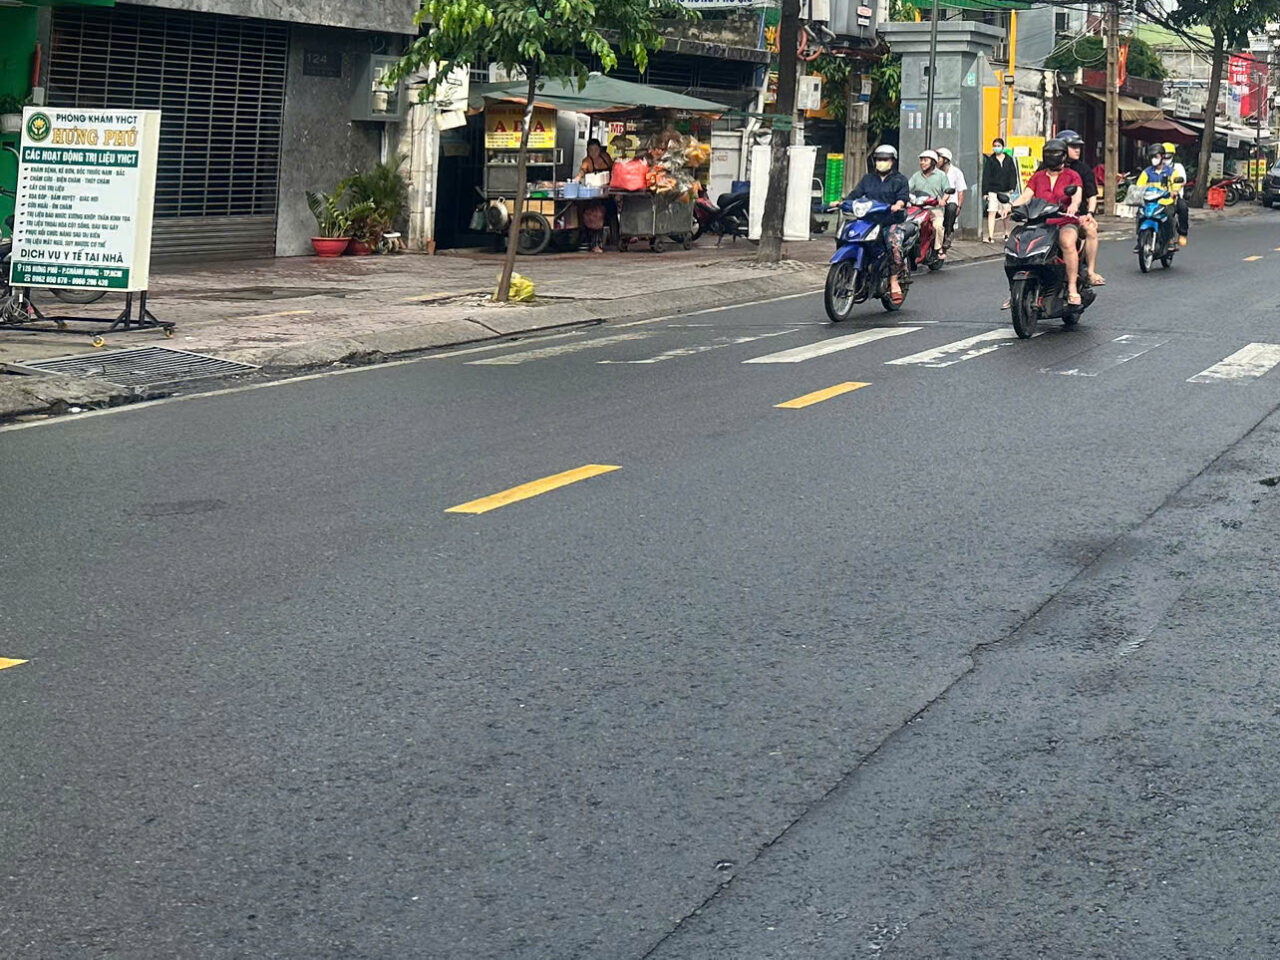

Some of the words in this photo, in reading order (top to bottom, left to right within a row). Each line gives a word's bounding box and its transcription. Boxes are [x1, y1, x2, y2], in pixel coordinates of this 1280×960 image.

[306, 53, 327, 64] 124
[56, 111, 87, 123] PHÒNG
[88, 112, 113, 124] KHÁM
[115, 114, 138, 124] YHCT
[52, 126, 99, 146] HƯNG
[103, 127, 139, 147] PHÚ
[25, 148, 41, 160] CÁC
[41, 150, 61, 163] HOẠT
[63, 150, 84, 163] ĐỘNG
[85, 152, 97, 165] TRỊ
[98, 152, 116, 165] LIỆU
[117, 153, 137, 164] YHCT
[21, 248, 45, 260] DỊCH
[48, 250, 60, 262] VỤ
[64, 251, 70, 259] Y
[72, 248, 84, 260] TẾ
[85, 252, 99, 263] TẠI
[102, 252, 123, 263] NHÀ
